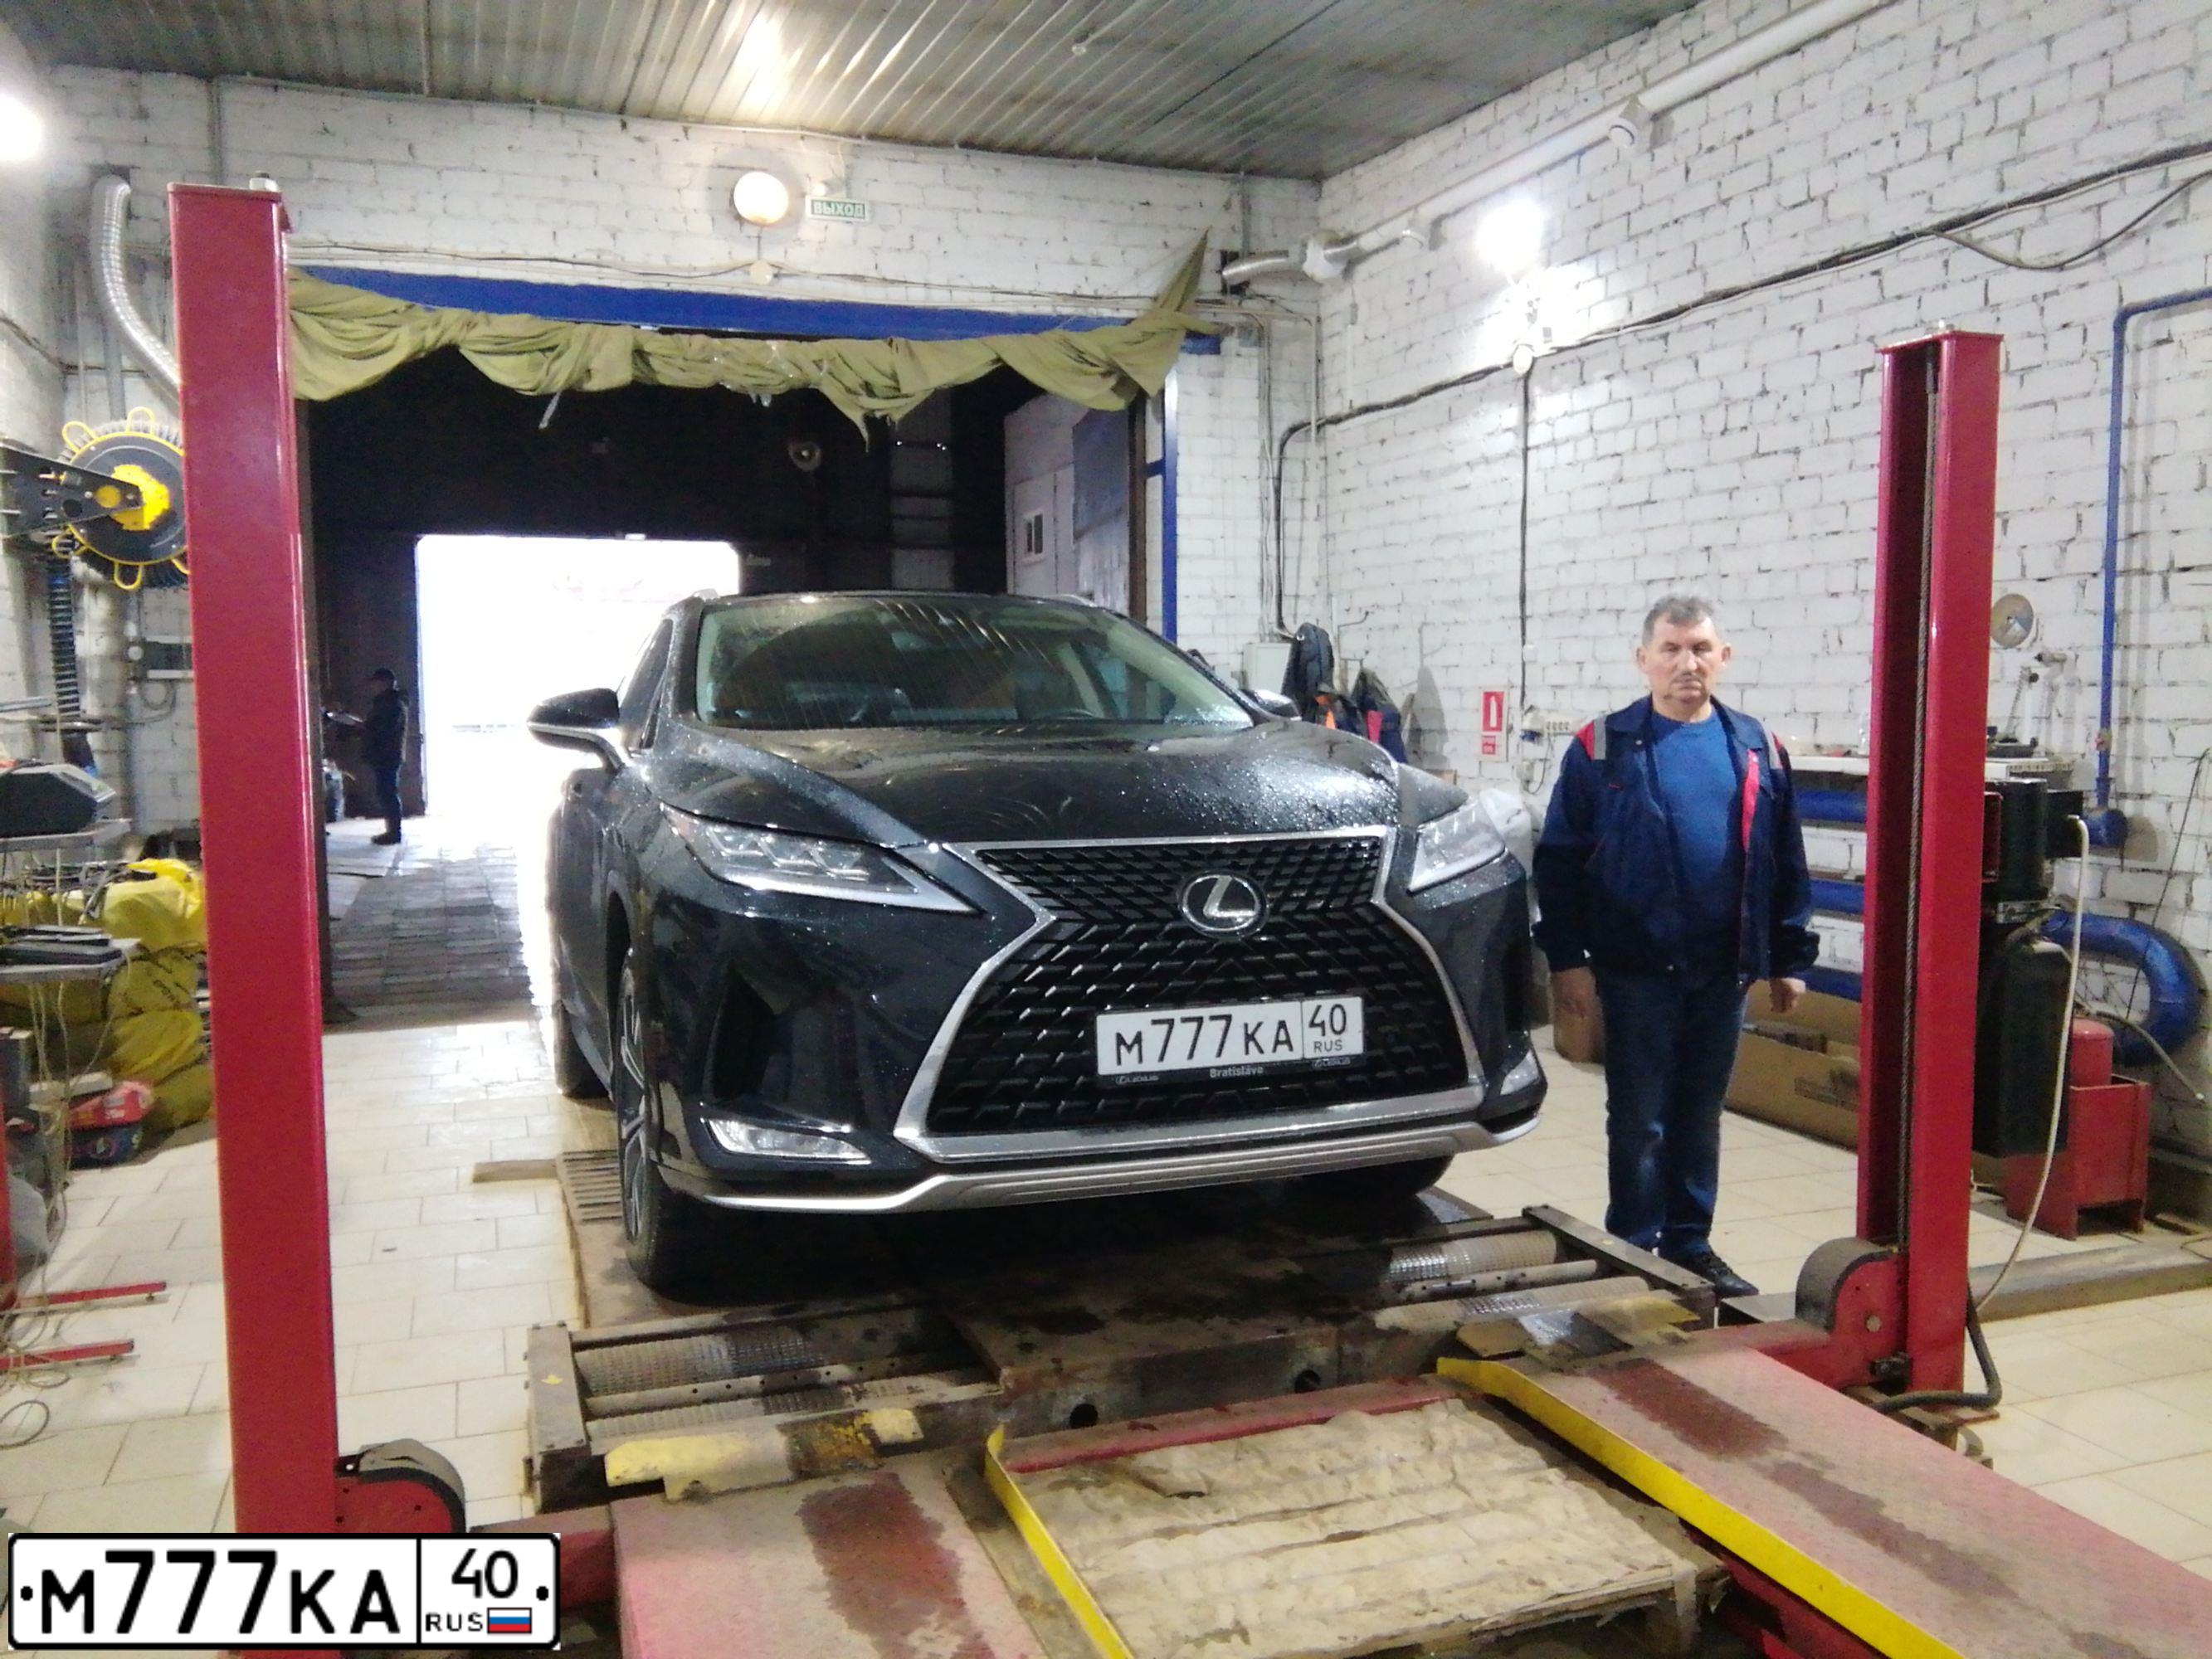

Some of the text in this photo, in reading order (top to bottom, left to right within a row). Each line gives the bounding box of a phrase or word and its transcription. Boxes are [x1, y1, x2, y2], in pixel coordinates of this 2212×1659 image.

[813, 202, 864, 217] ВЫХОД
[1308, 1004, 1347, 1037] 40
[1313, 1039, 1342, 1053] RUS
